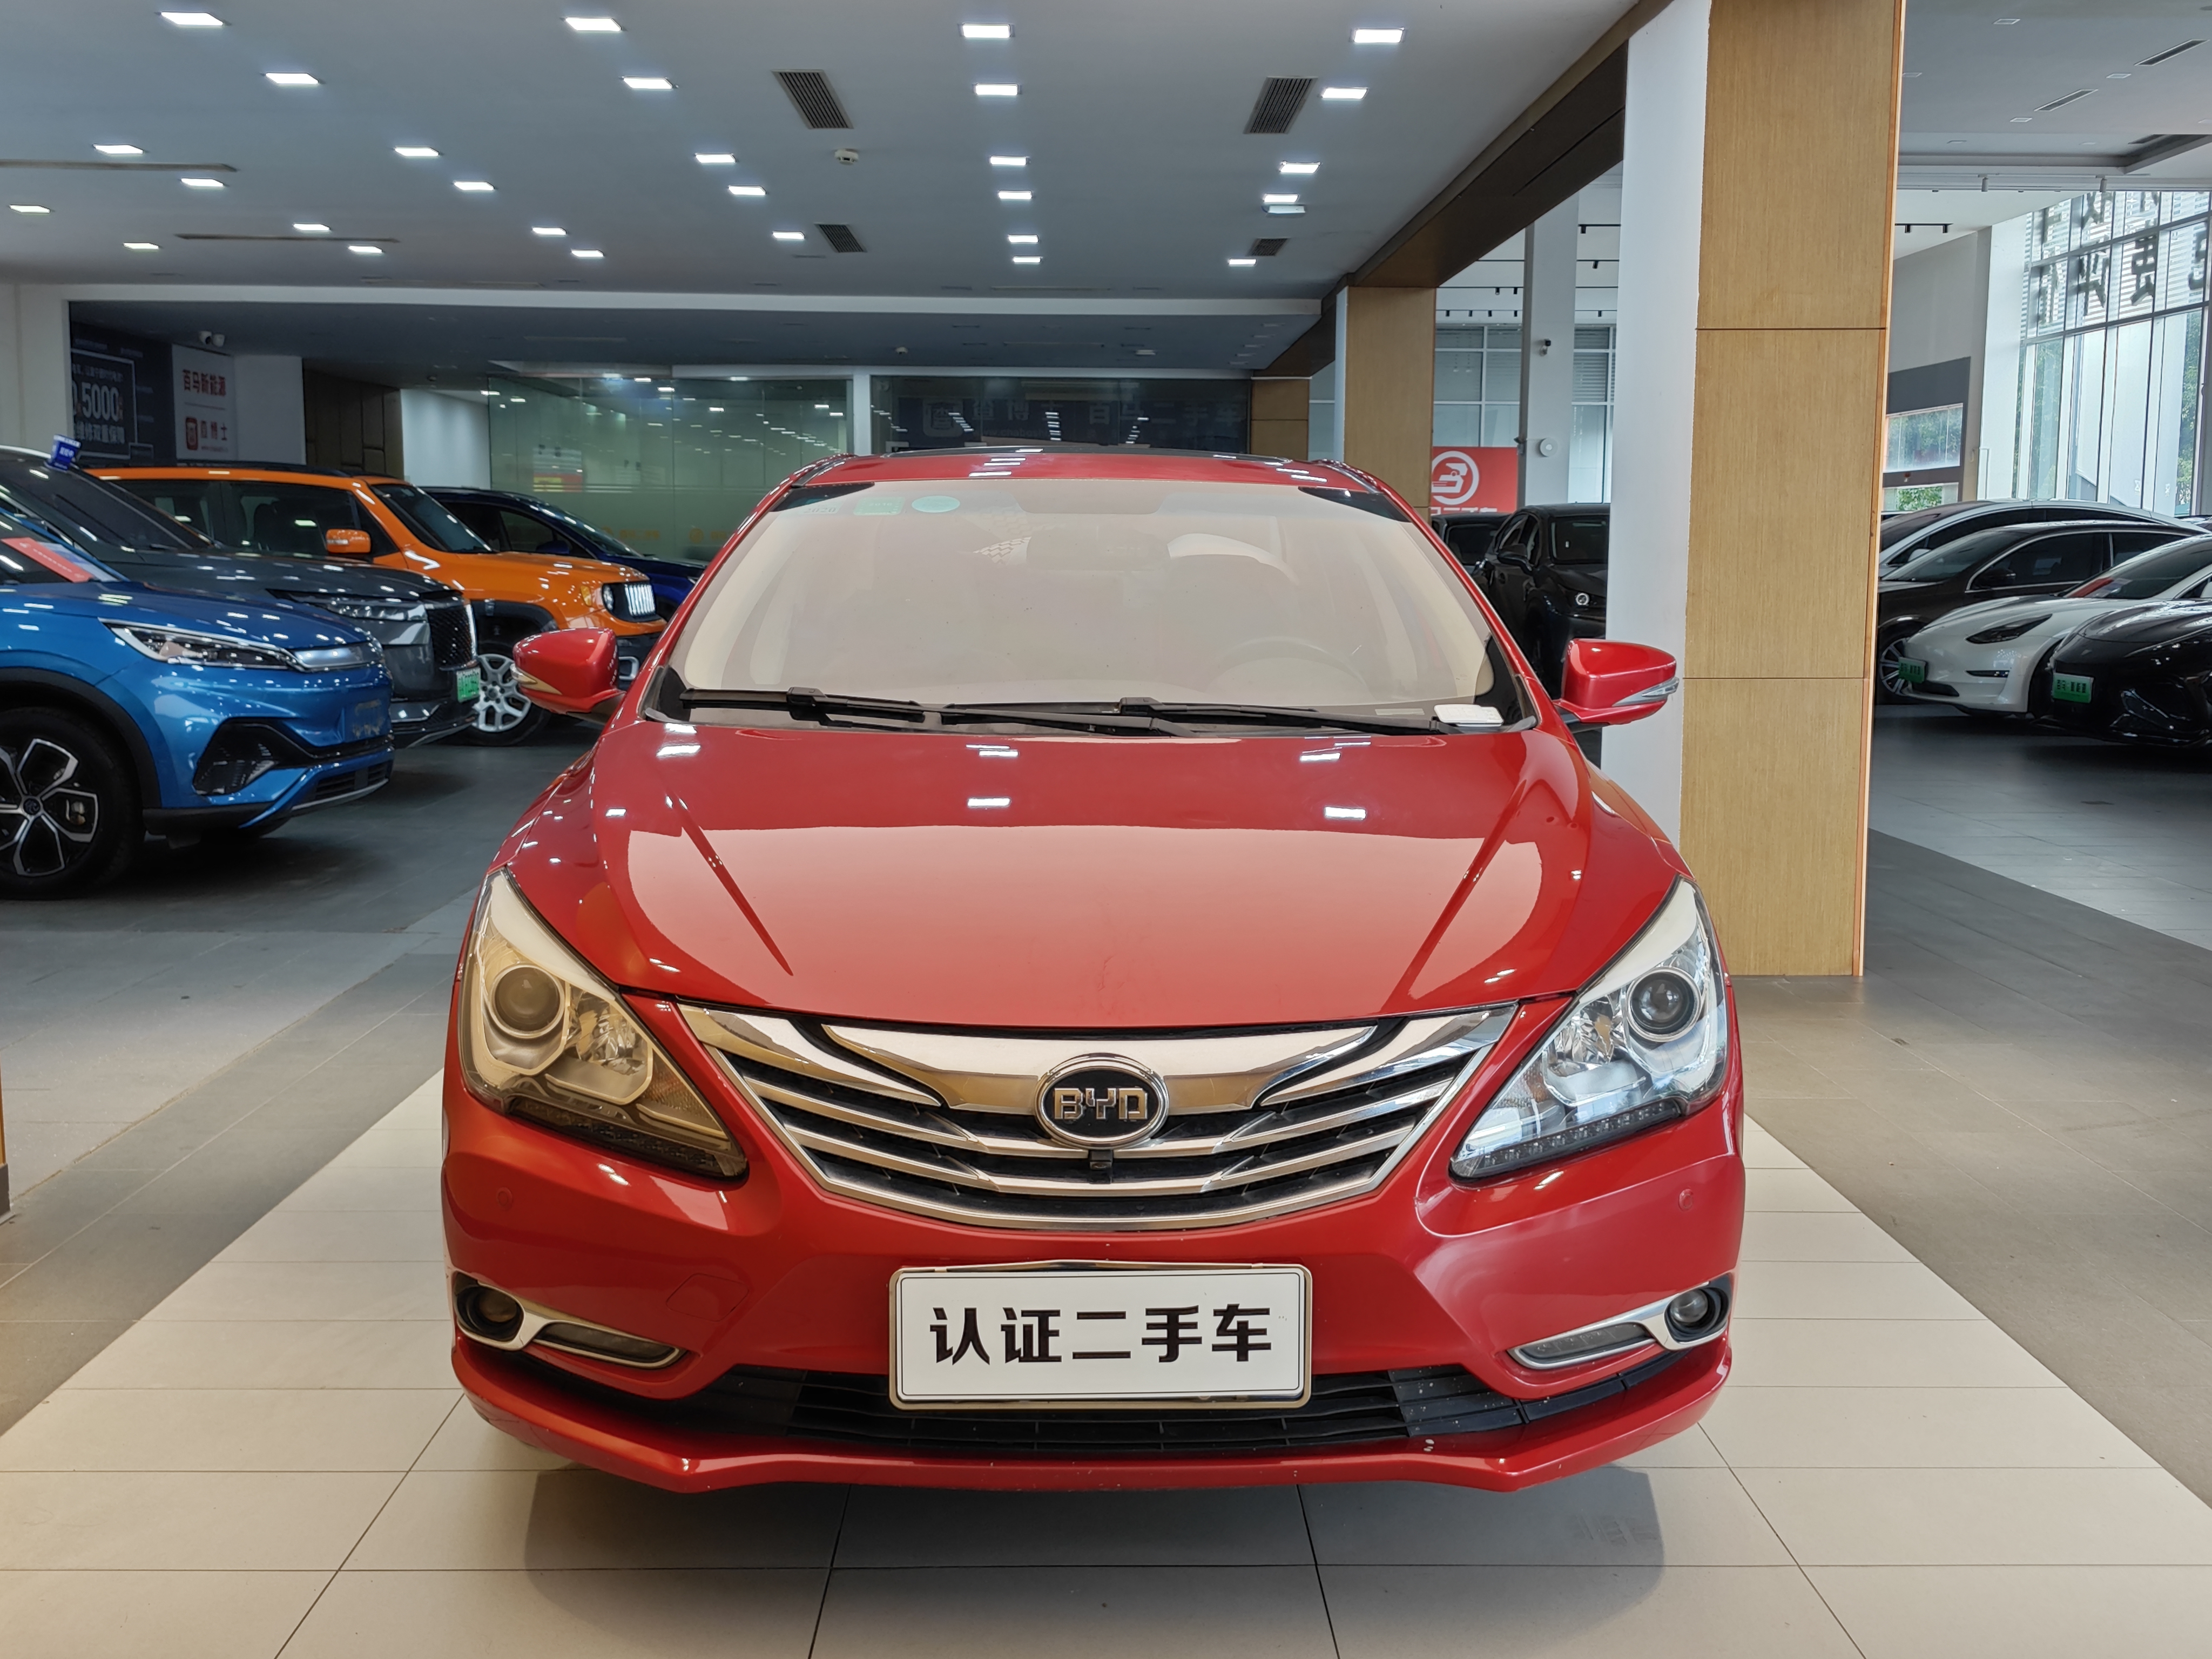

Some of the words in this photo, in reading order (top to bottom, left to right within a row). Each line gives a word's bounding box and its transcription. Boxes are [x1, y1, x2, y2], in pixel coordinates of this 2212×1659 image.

[1054, 1087, 1148, 1120] BYD
[929, 1303, 1272, 1365] 认证二手车
